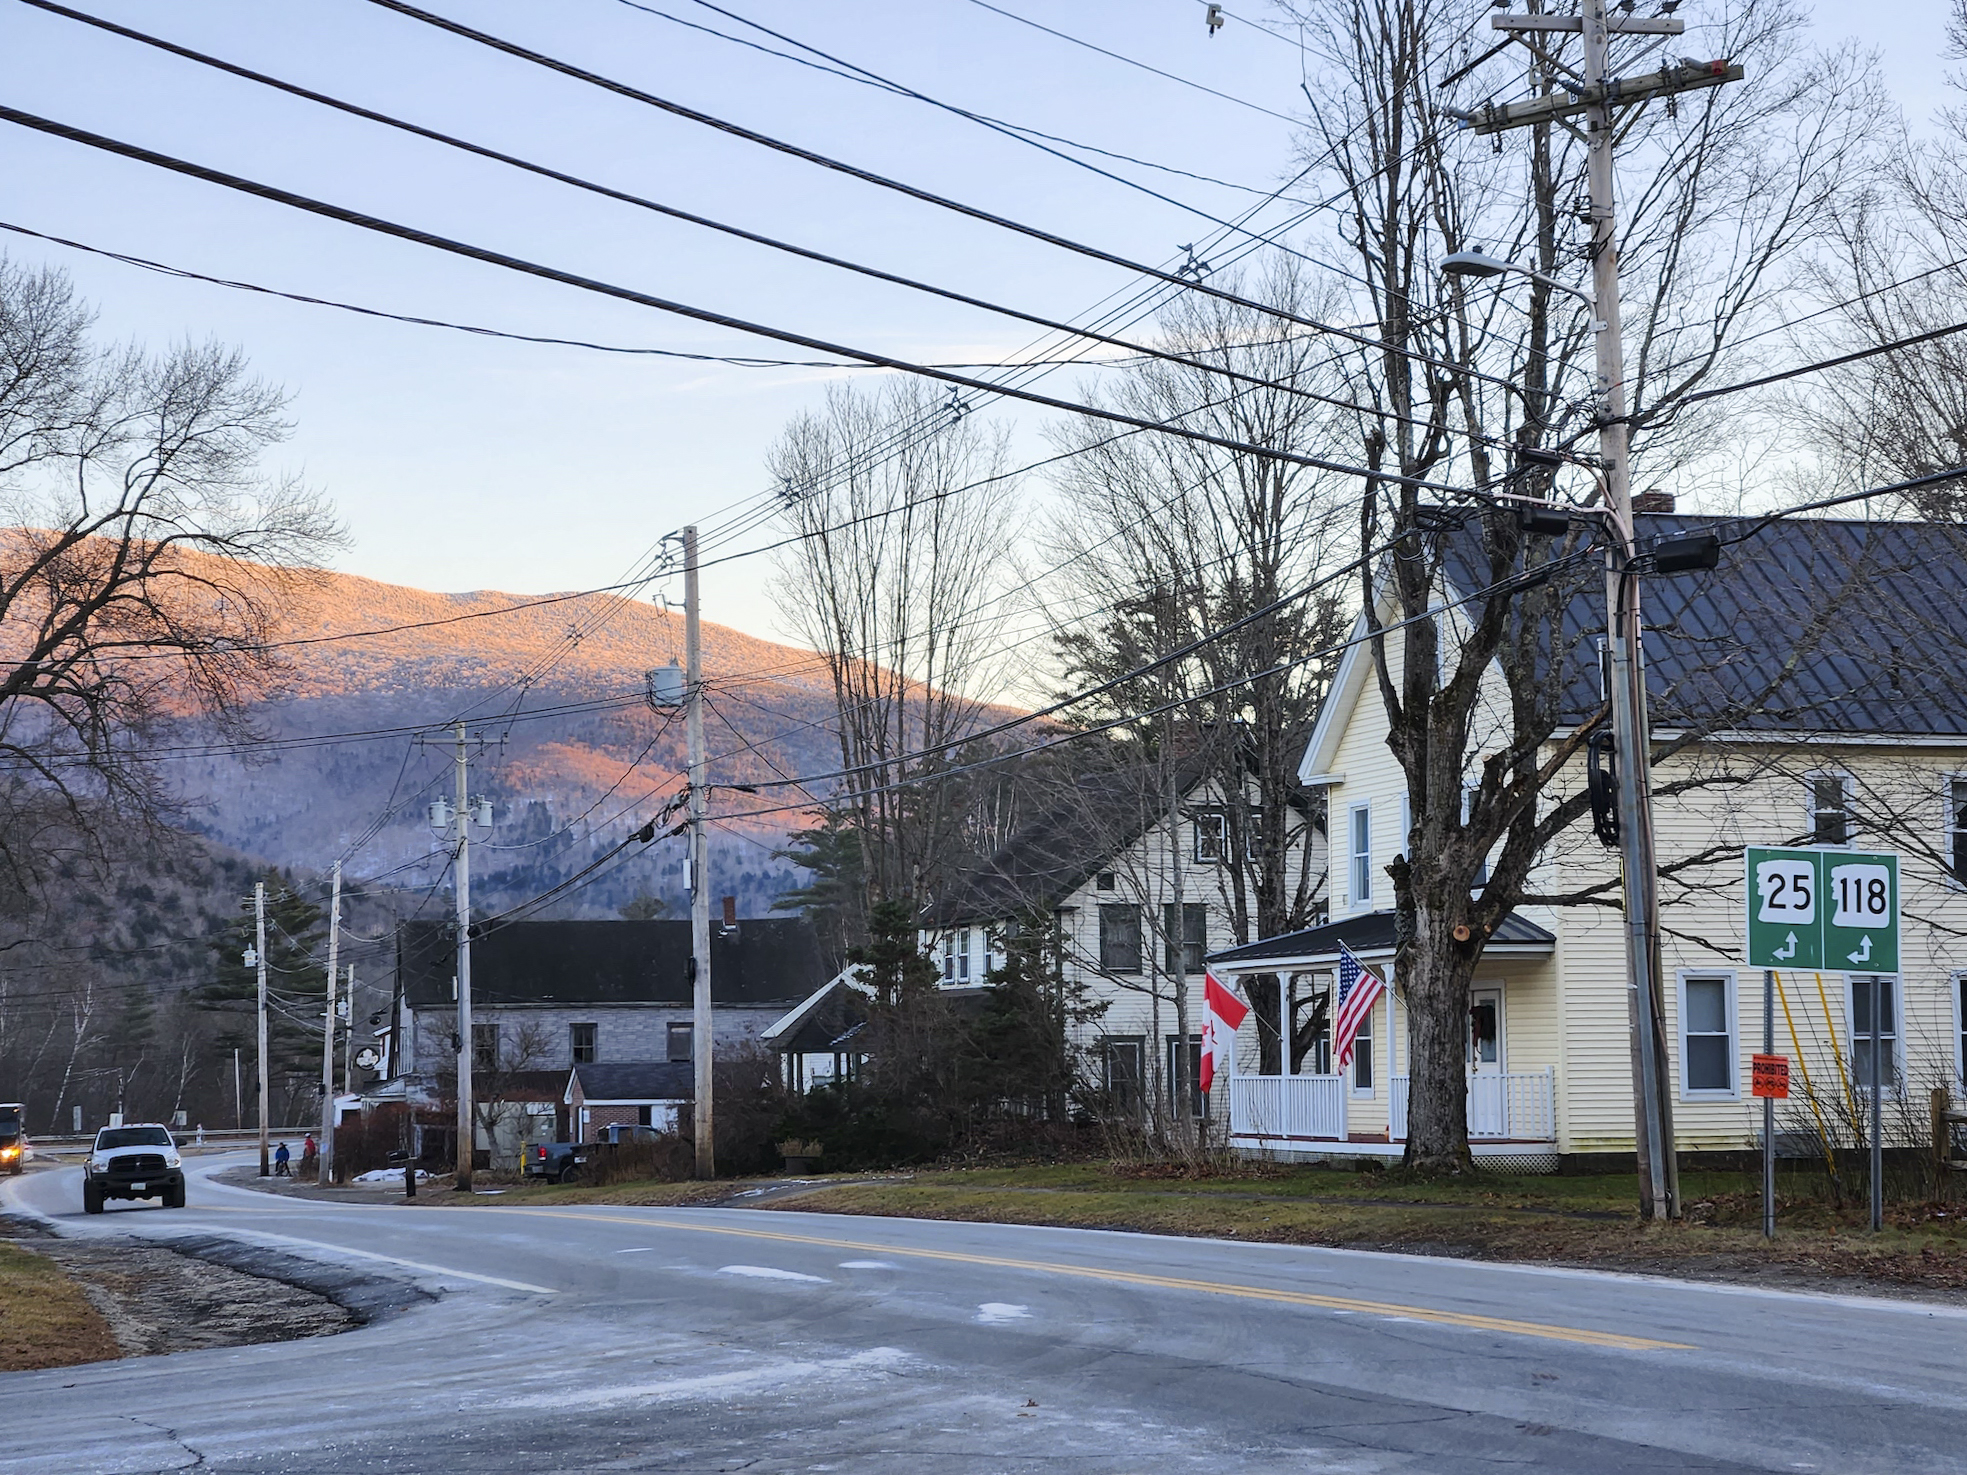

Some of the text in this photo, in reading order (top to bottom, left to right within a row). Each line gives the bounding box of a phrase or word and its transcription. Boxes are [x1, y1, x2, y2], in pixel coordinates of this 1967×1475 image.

[1767, 873, 1811, 911] 25
[1840, 877, 1887, 915] 118
[1753, 1062, 1788, 1076] PROHIBITED
